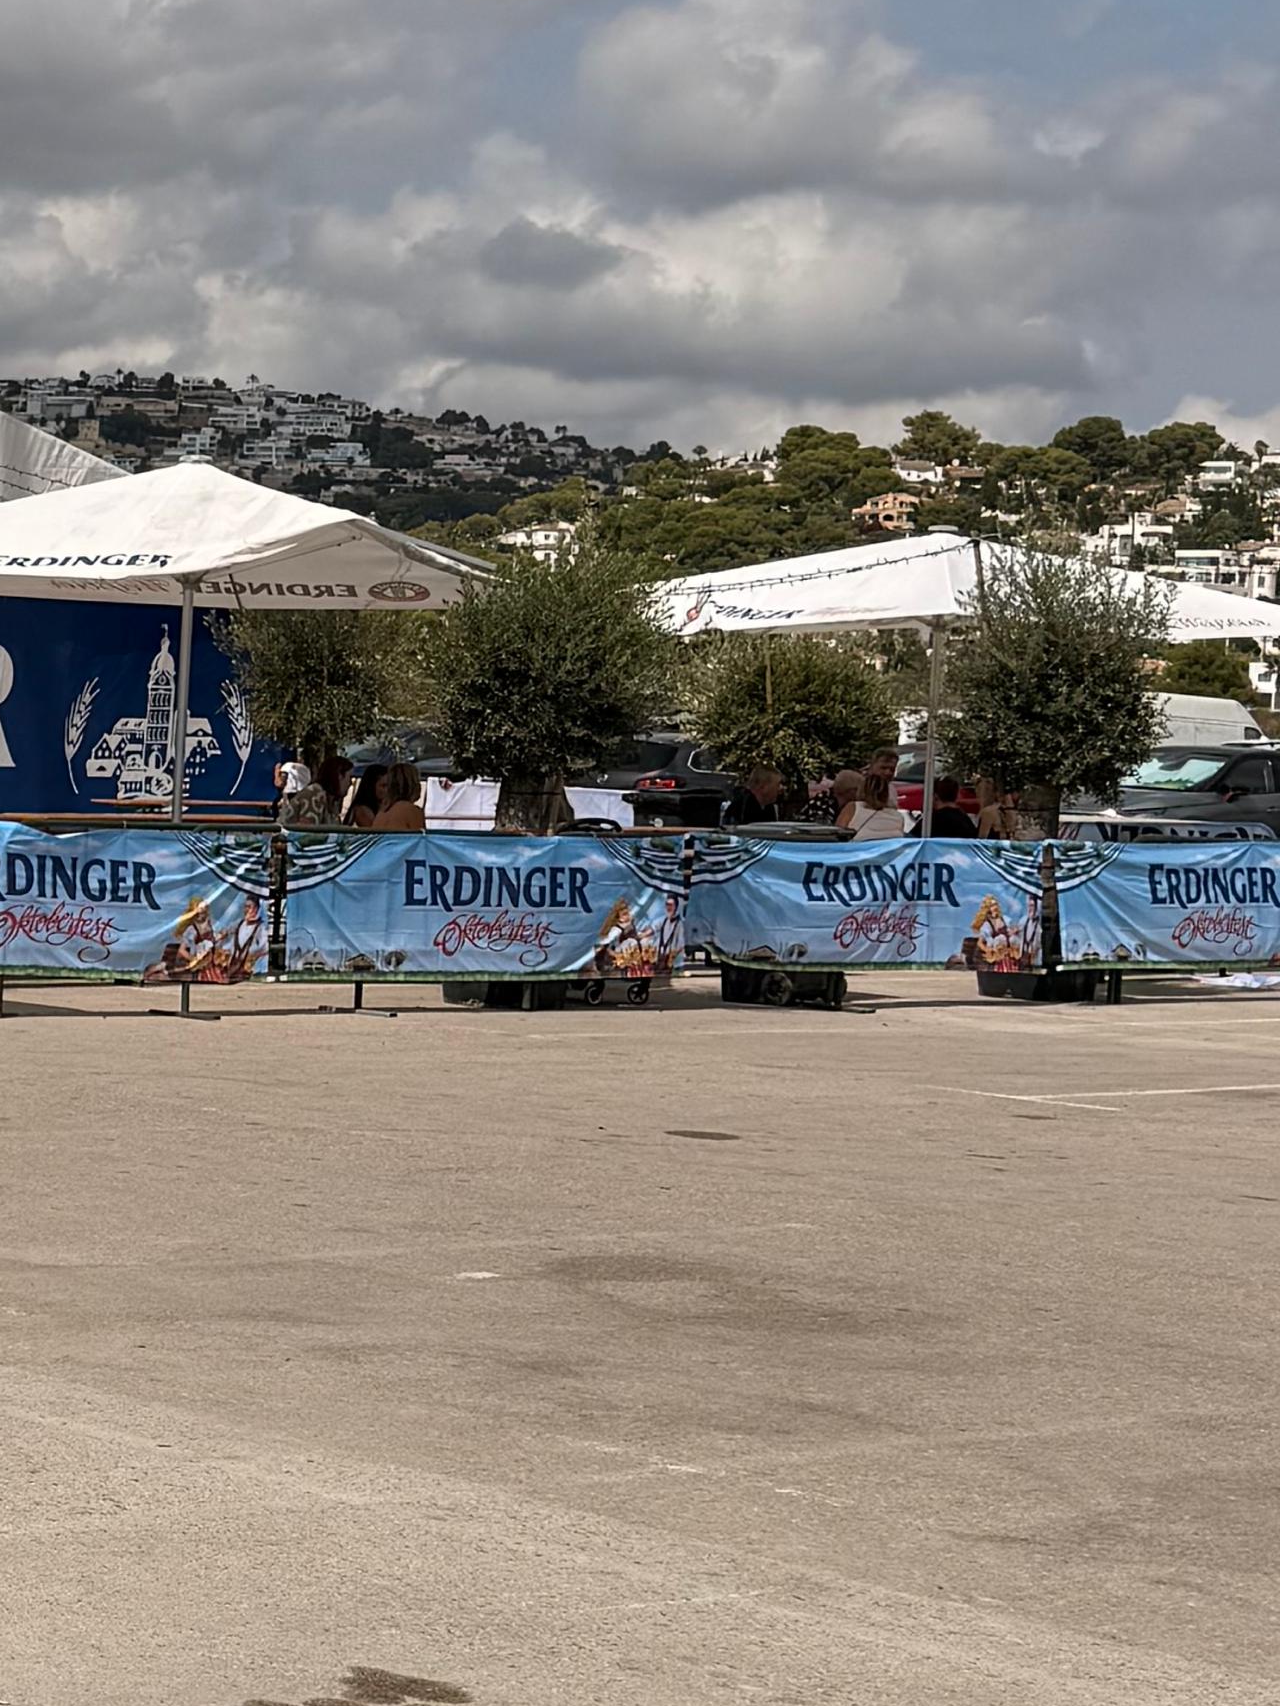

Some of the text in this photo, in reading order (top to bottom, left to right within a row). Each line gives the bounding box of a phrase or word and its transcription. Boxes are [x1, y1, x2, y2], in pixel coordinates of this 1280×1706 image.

[403, 859, 594, 914] ERDINGER
[802, 861, 961, 908] ERDINGER
[1147, 863, 1280, 909] ERDINGER
[432, 909, 564, 967] Oktoberfest
